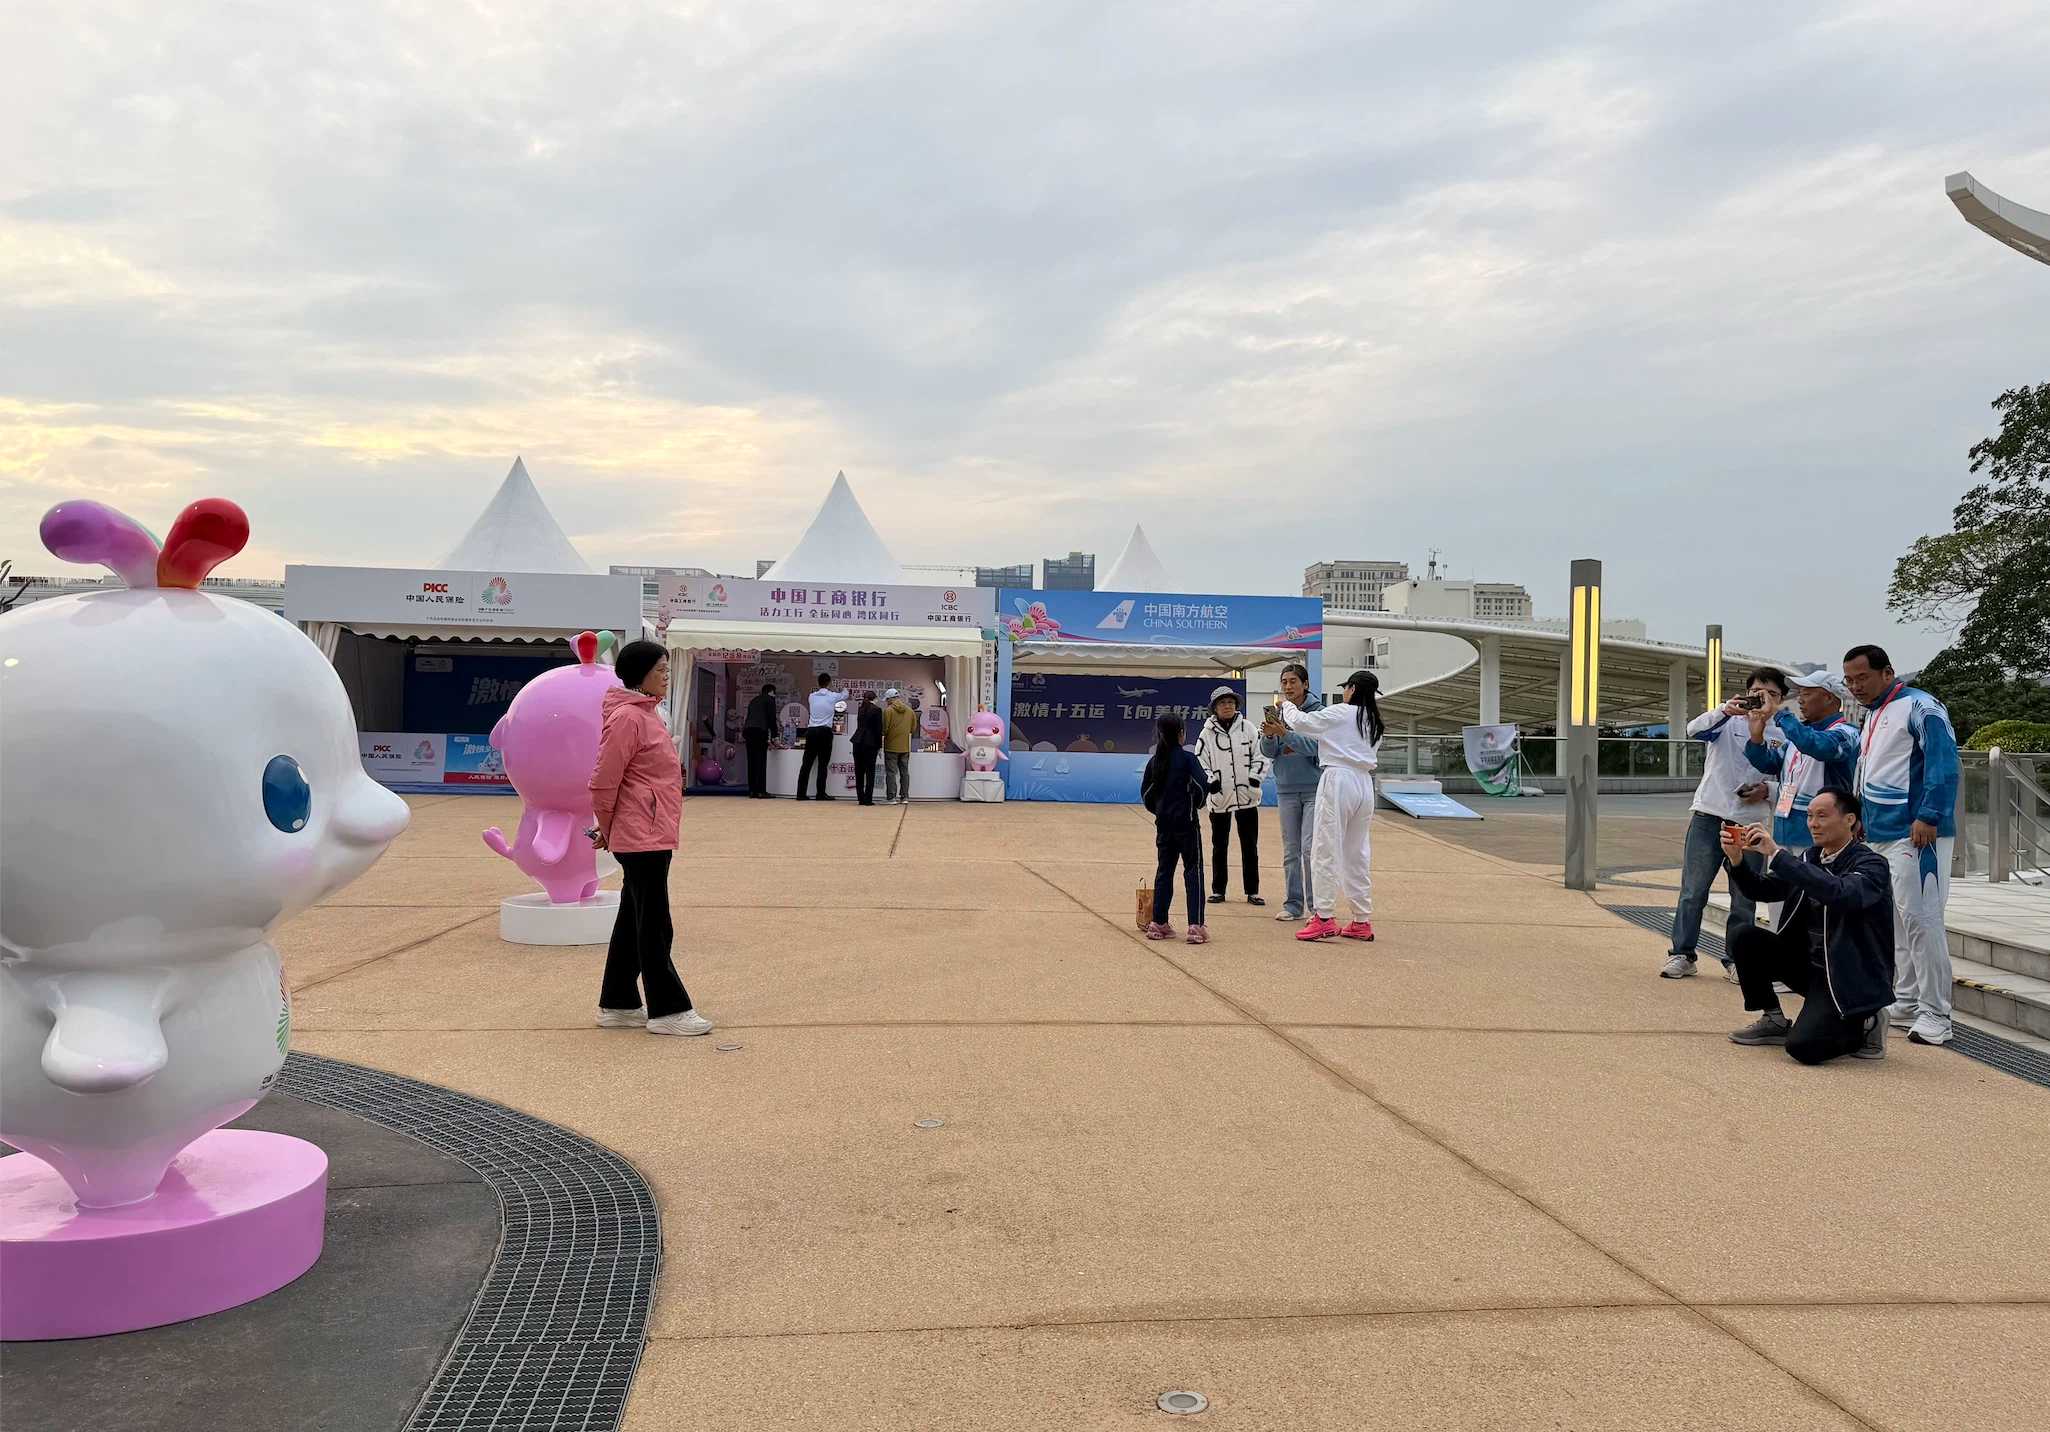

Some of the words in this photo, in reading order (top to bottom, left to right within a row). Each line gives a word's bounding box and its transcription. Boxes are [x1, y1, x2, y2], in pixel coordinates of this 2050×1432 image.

[423, 583, 448, 593] PICC
[406, 594, 465, 604] 中国人民保险
[770, 587, 888, 607] 中国工商银行
[759, 607, 803, 618] 活力工行
[1144, 602, 1228, 619] 中国南方航空
[927, 614, 971, 623] 中国工商银行
[1143, 618, 1173, 629] CHINA
[1176, 618, 1228, 630] SOUTHERN
[1012, 702, 1105, 719] 激情十五运
[373, 744, 392, 752] PICC
